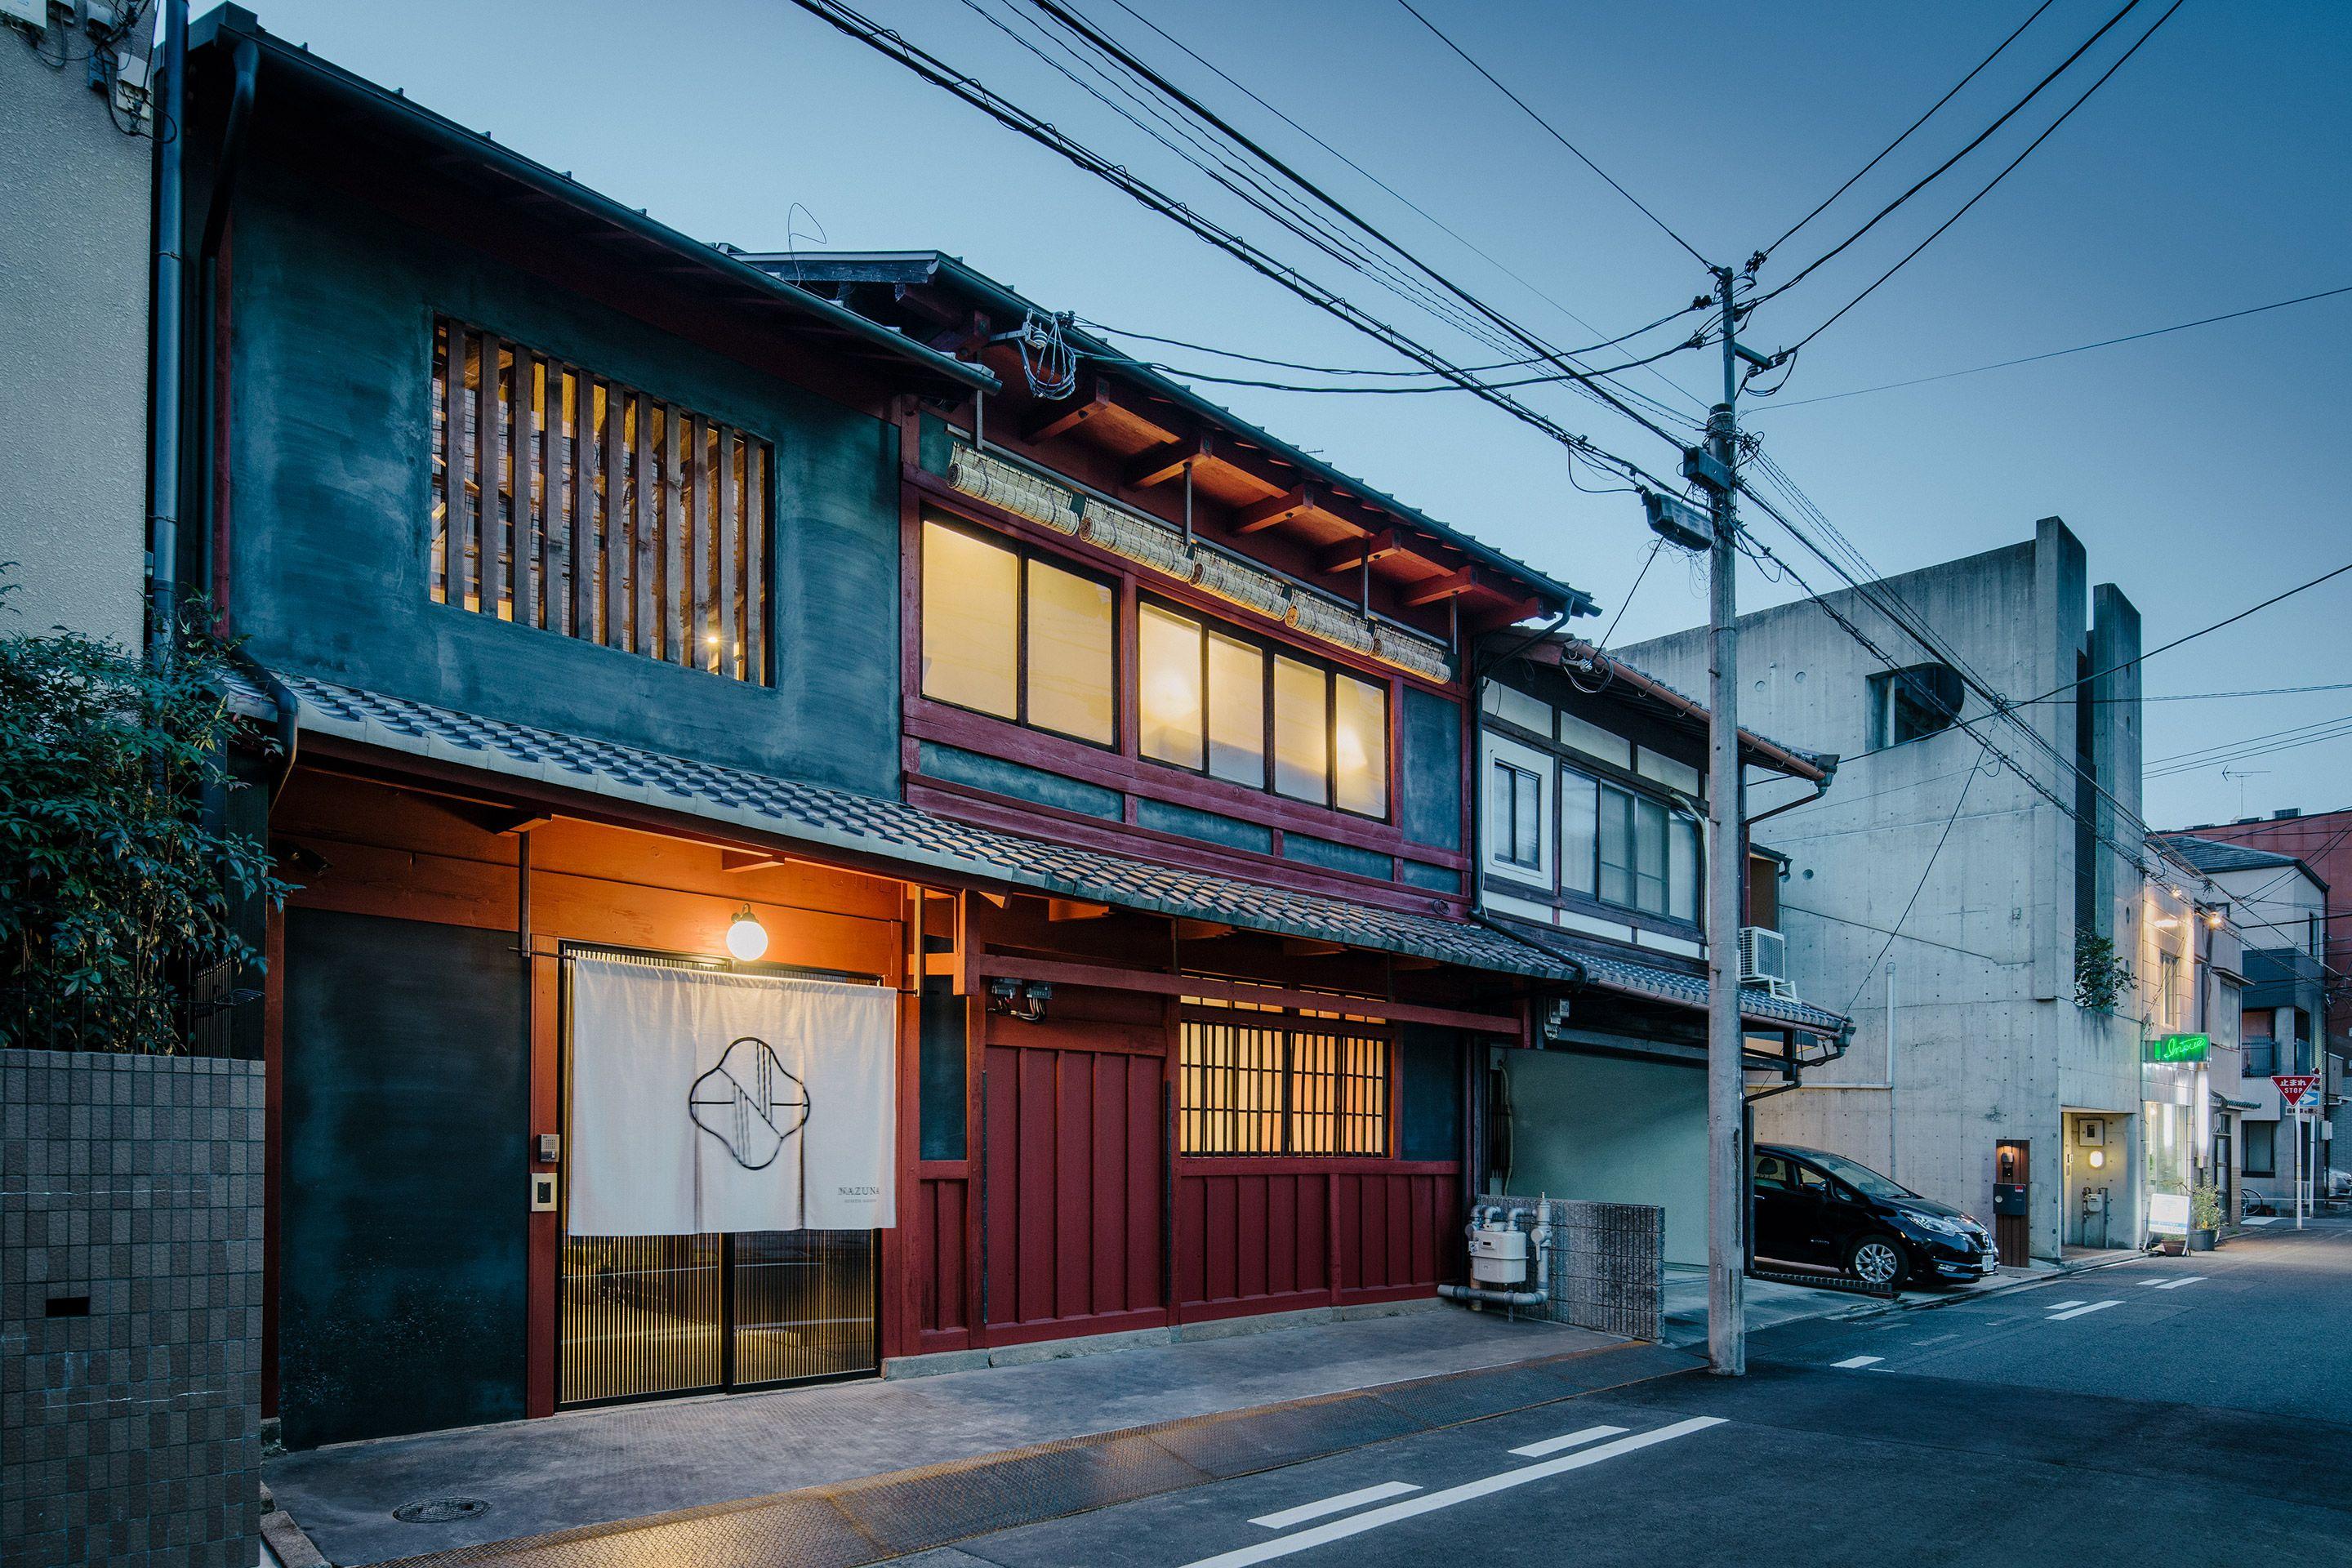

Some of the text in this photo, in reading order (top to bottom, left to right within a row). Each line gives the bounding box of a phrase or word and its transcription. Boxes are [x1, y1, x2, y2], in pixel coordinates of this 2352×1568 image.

[2163, 1037, 2205, 1058] Inoue
[2280, 1079, 2307, 1087] 止まれ
